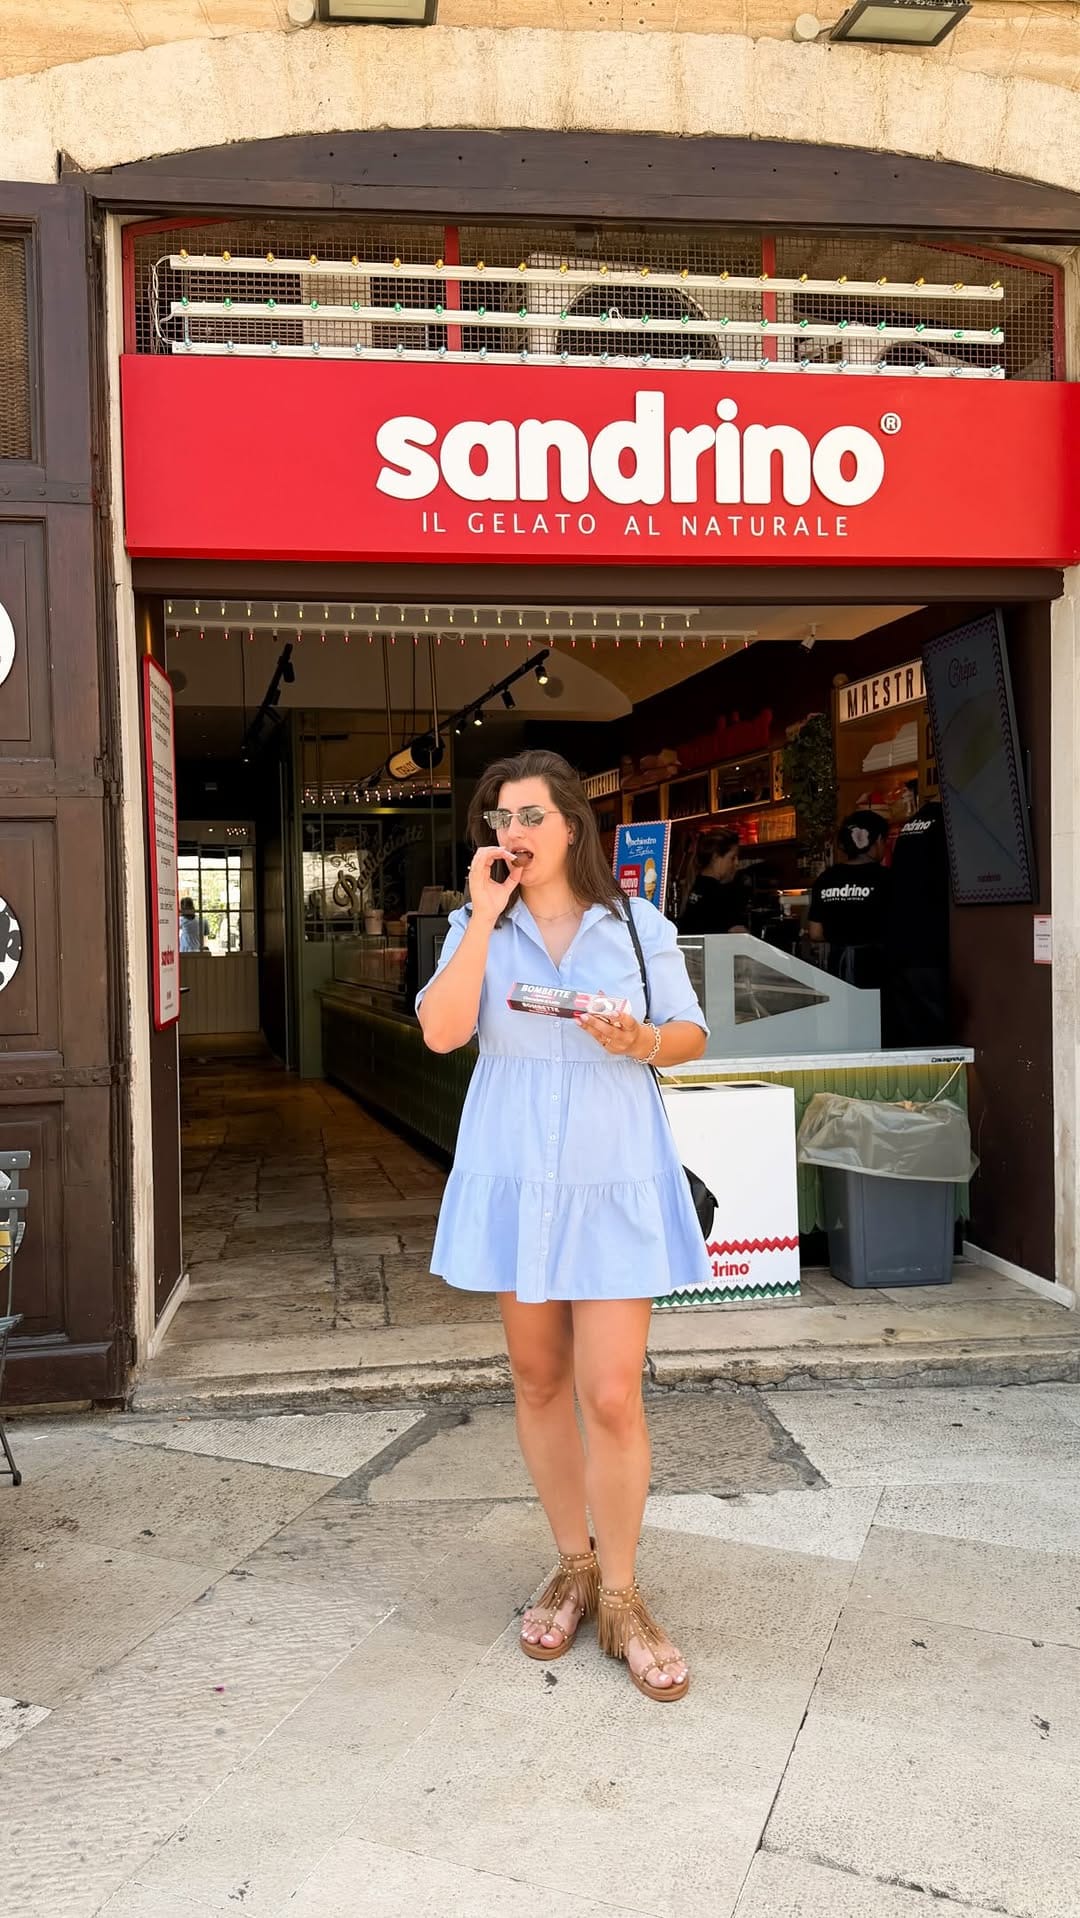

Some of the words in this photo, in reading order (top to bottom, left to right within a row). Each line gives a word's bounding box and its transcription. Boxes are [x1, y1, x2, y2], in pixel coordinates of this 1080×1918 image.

[376, 391, 885, 506] sandrino
[422, 512, 446, 533] IL
[468, 513, 597, 535] GELATO
[624, 516, 661, 537] AL
[681, 516, 849, 537] NATURALE
[821, 884, 870, 899] sandrino
[521, 985, 571, 998] BOMBETTE
